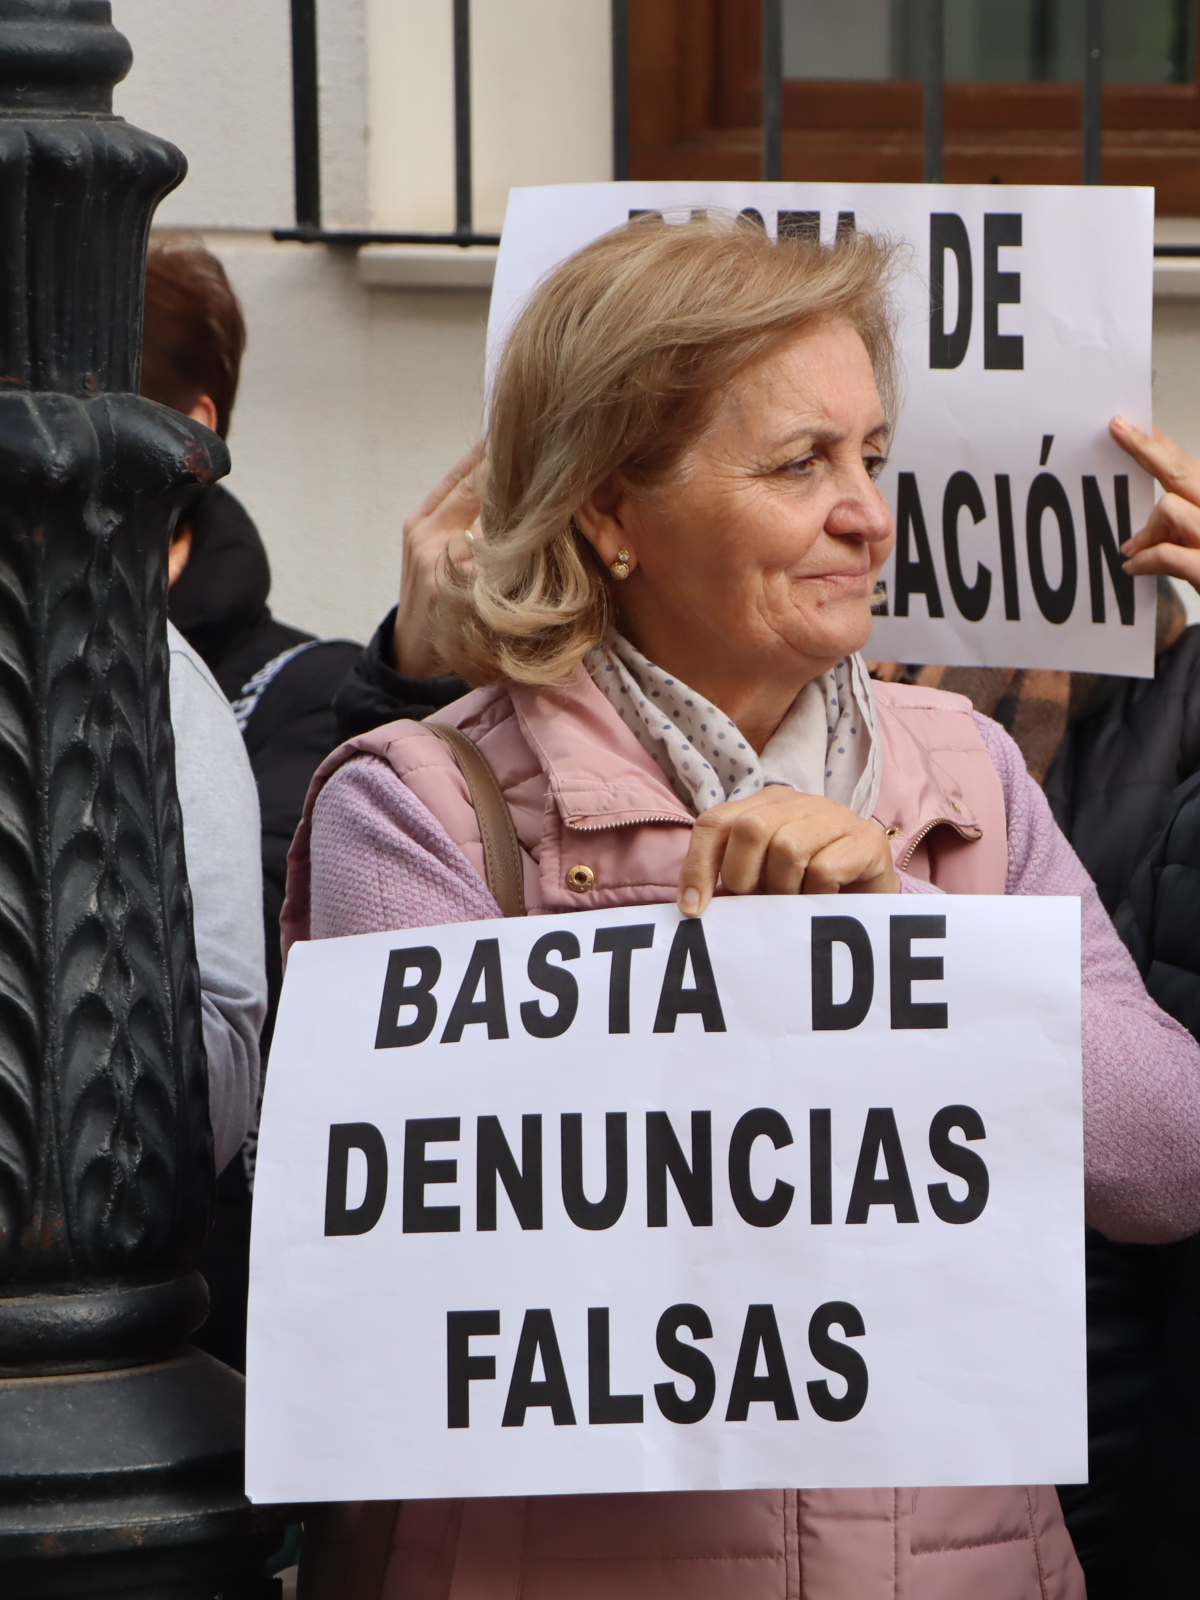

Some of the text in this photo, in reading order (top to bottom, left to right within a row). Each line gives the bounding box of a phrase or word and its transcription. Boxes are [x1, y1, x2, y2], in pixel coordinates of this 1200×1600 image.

[929, 212, 1024, 370] DE
[871, 434, 1136, 626] ACIÓN
[374, 914, 949, 1050] BASTA DE
[323, 1104, 991, 1237] DENUNCIAS
[446, 1300, 869, 1430] FALSAS
